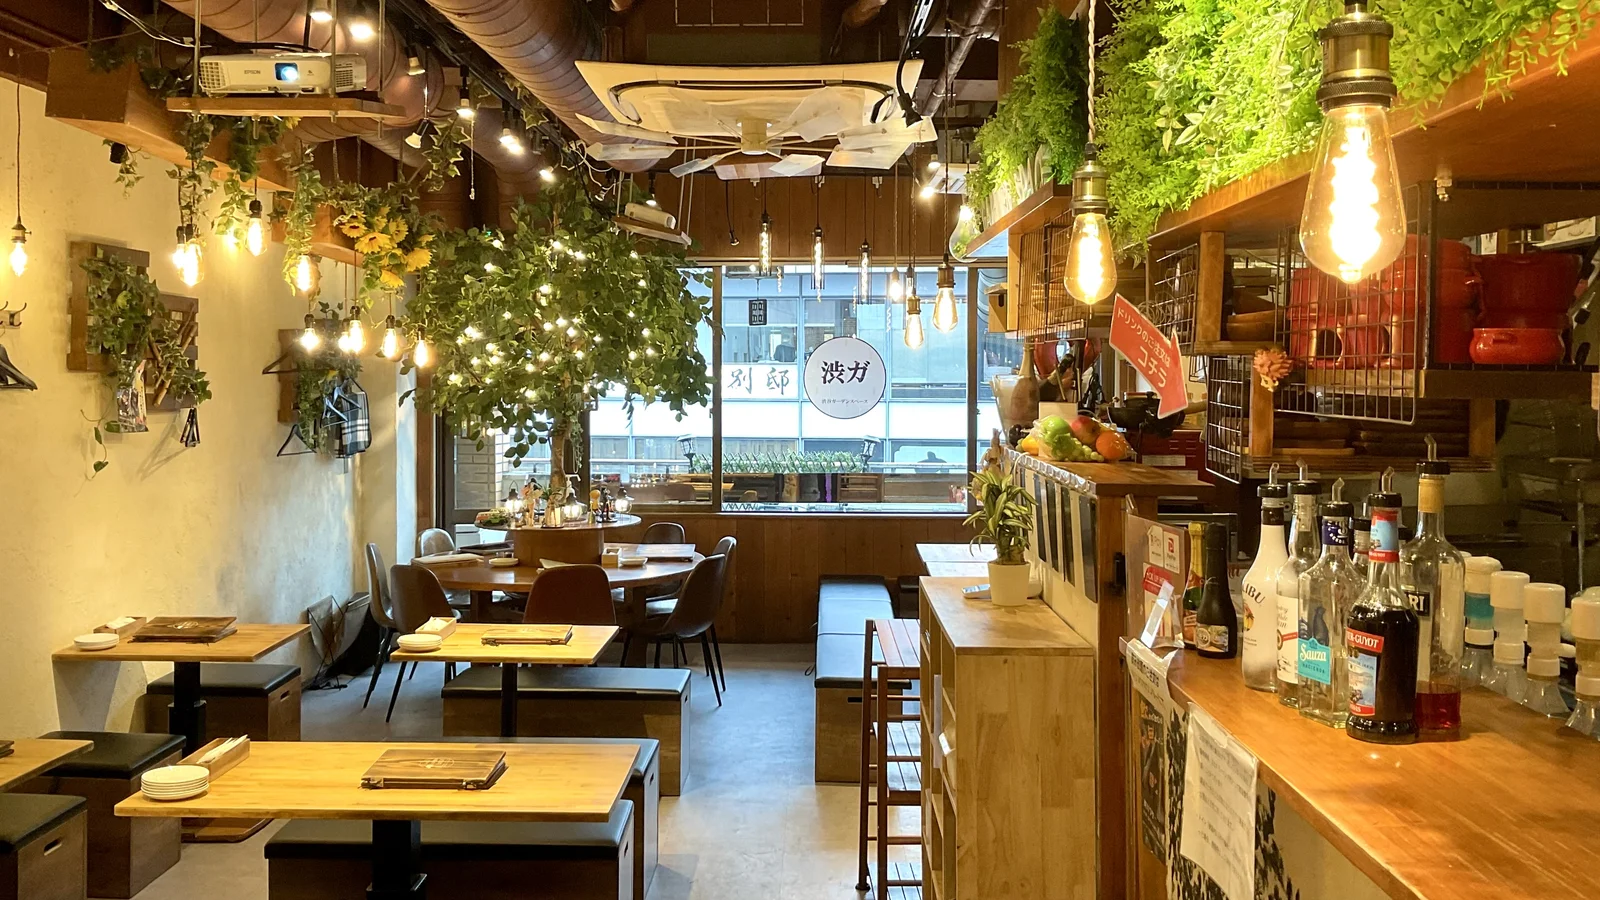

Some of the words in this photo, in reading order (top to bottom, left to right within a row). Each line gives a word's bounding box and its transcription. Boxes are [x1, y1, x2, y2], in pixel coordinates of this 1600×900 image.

[821, 360, 871, 384] 渋ガ
[1138, 345, 1168, 388] コチラ
[1300, 642, 1327, 662] Sauza
